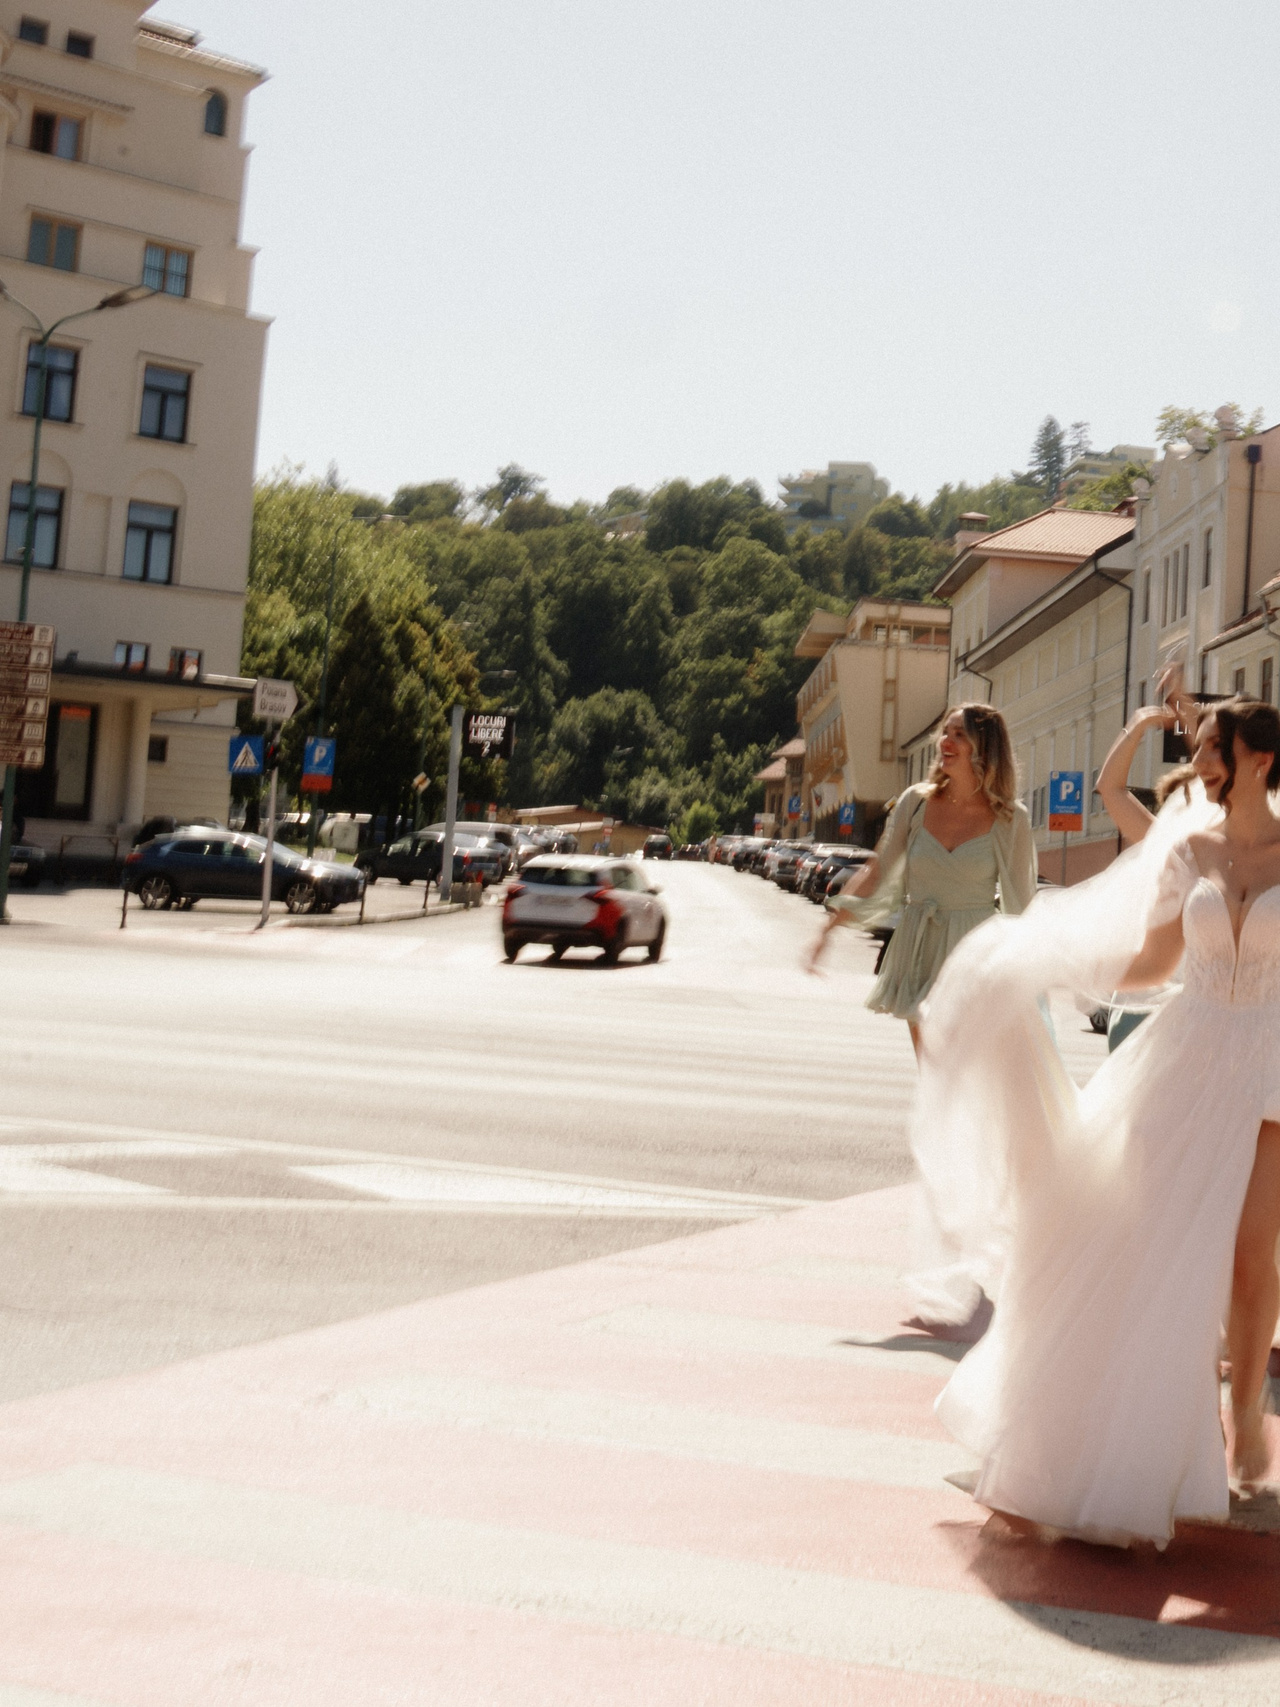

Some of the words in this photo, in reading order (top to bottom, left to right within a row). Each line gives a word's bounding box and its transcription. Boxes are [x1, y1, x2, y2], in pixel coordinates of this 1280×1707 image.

[470, 714, 507, 728] LOCURI
[470, 727, 505, 742] LIBERE
[1061, 780, 1075, 801] P
